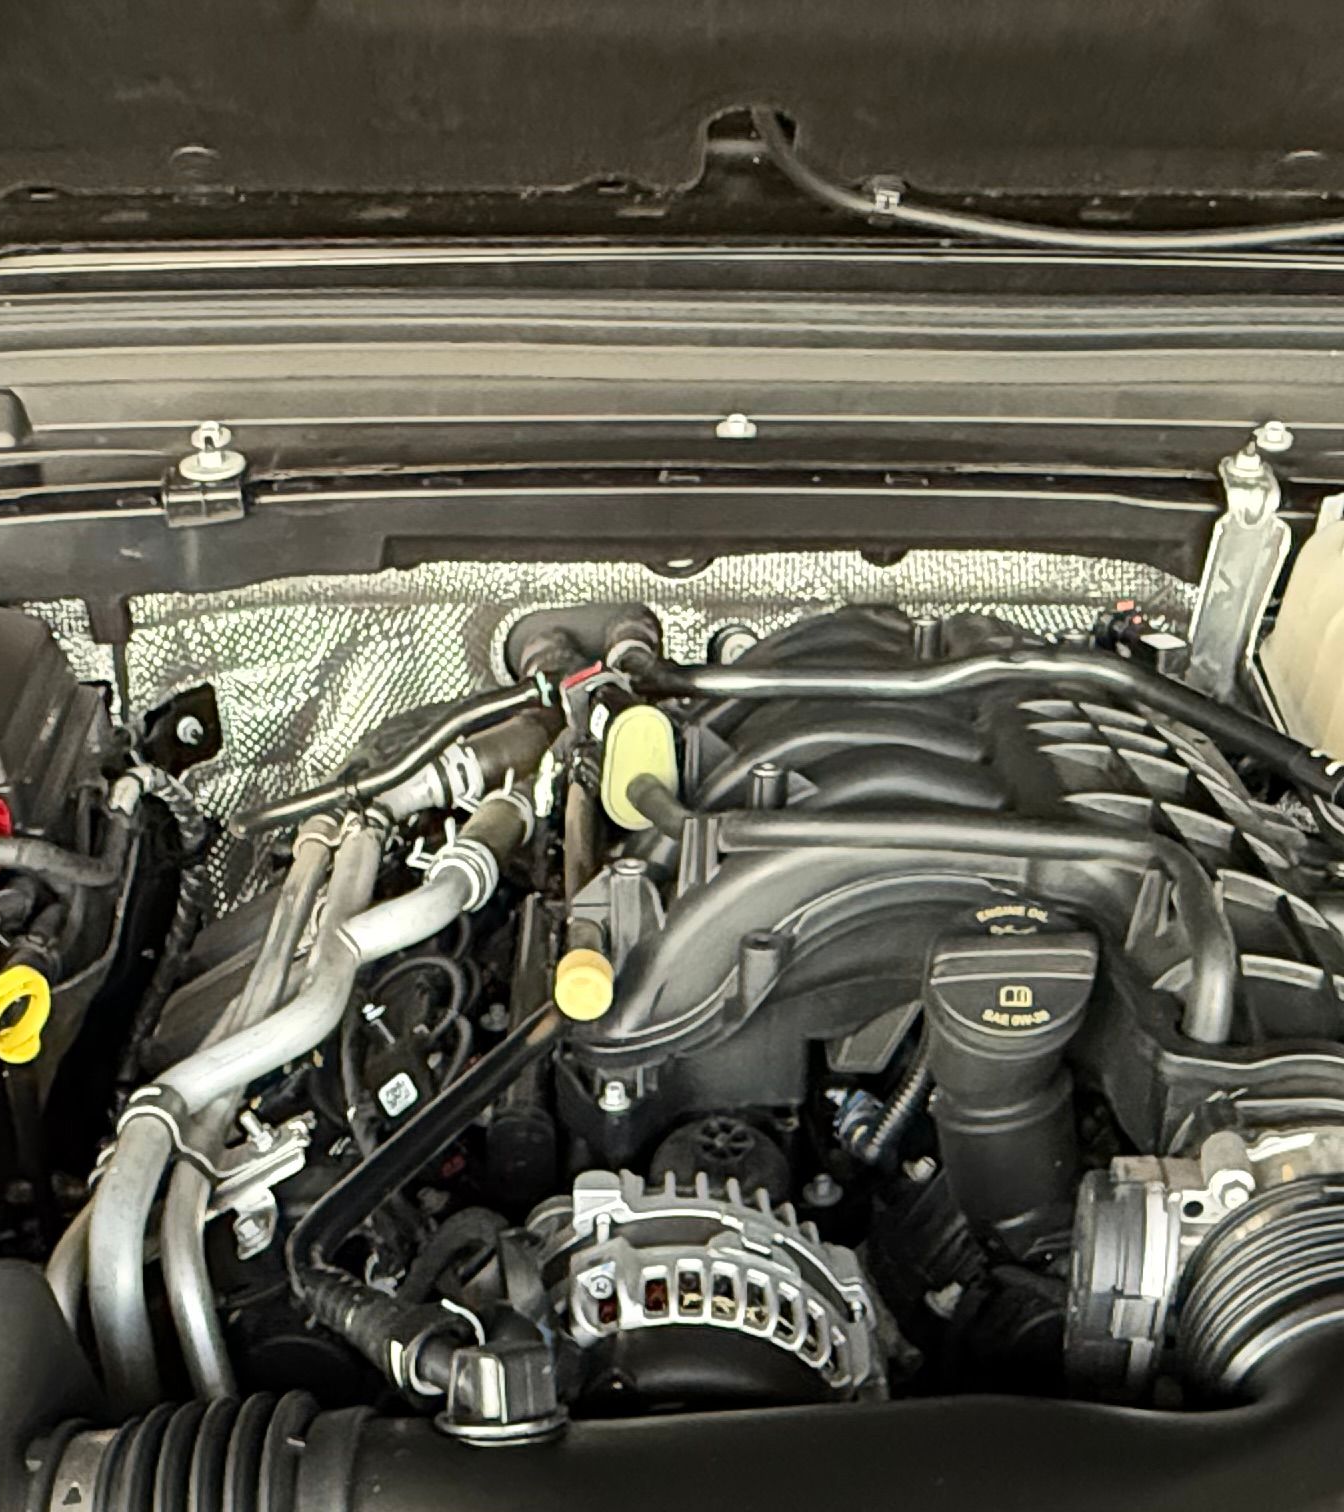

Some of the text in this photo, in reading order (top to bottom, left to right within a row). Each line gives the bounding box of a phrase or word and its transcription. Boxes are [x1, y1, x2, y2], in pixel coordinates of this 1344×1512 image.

[976, 905, 1049, 924] ENGINE OIL
[981, 1008, 1010, 1027] SAE
